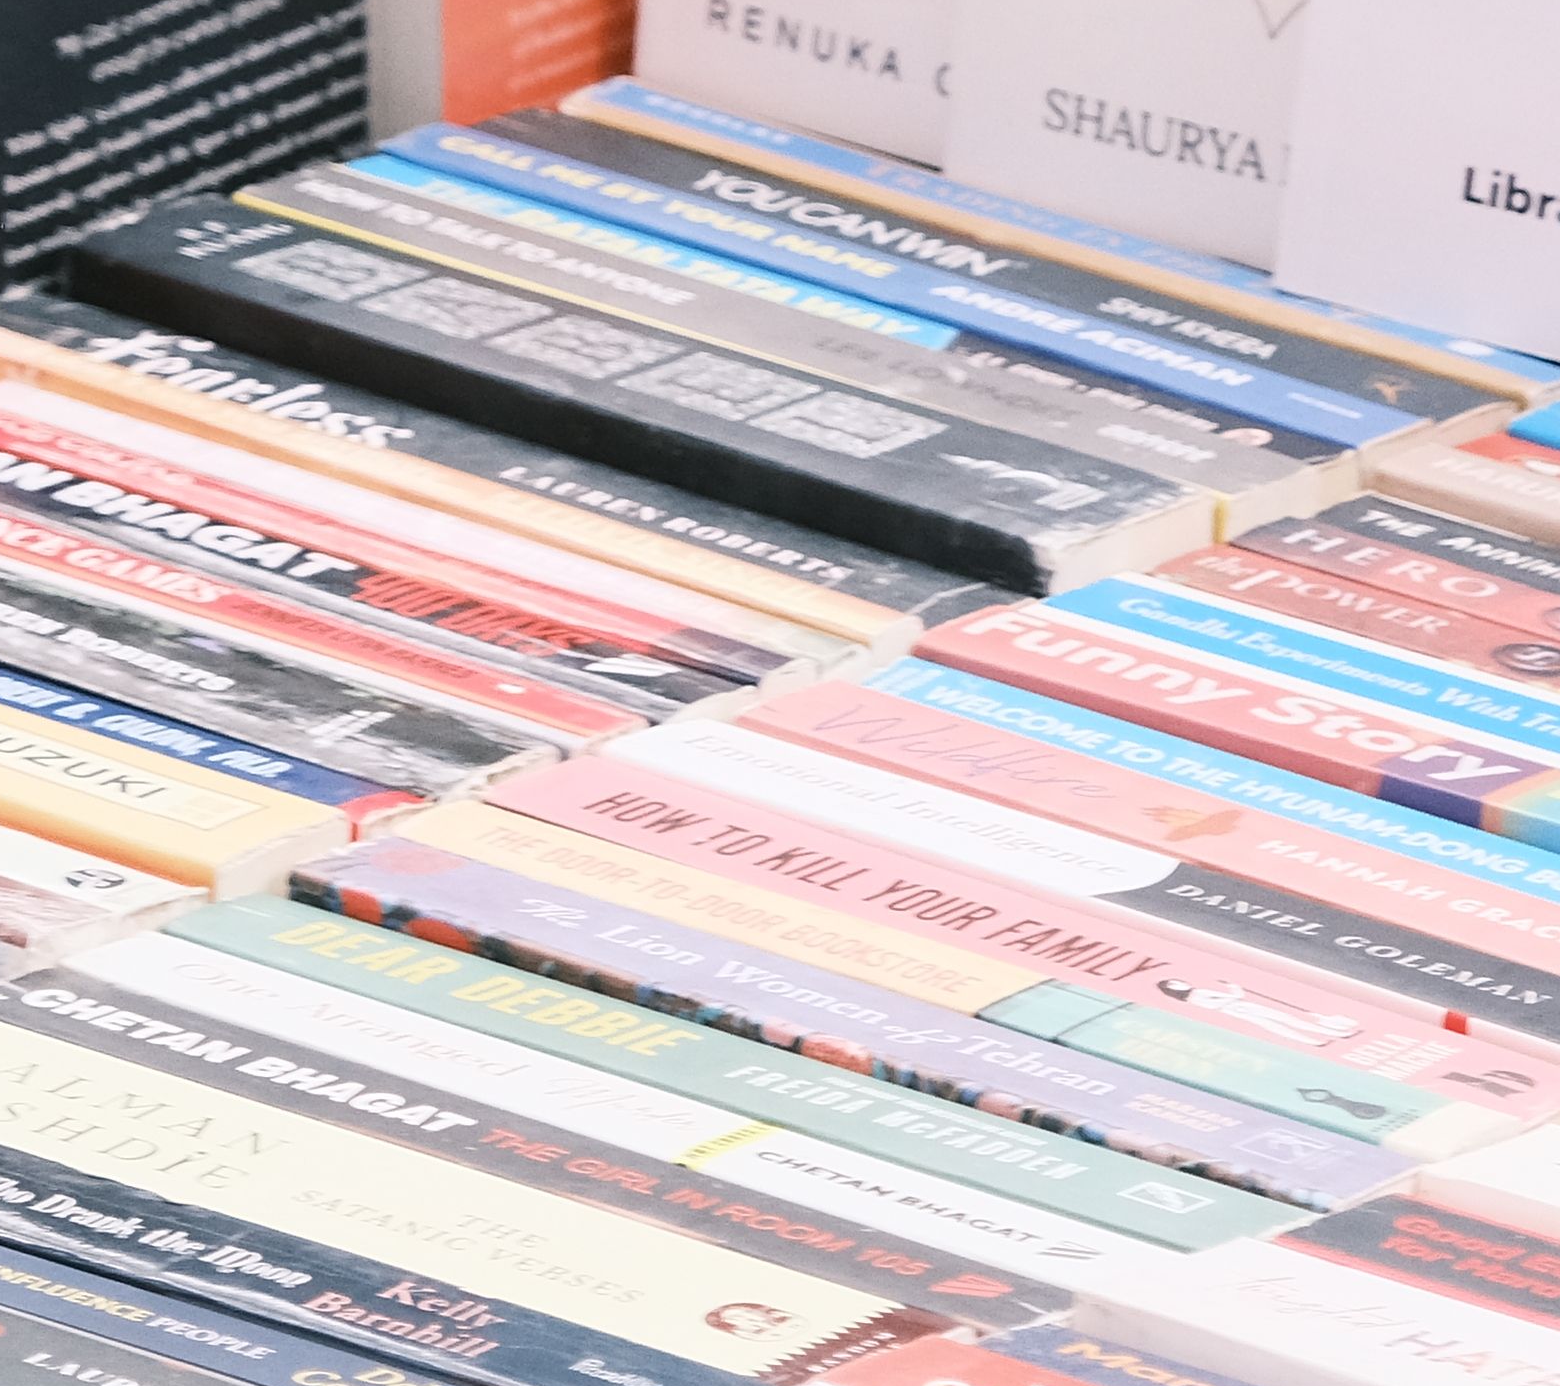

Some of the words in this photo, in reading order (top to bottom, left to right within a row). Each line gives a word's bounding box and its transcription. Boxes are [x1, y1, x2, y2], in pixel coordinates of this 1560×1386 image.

[1044, 88, 1268, 183] SHAURYA
[52, 474, 359, 578] BHAGAT
[1281, 525, 1503, 601] HERO
[1357, 508, 1426, 539] THE
[922, 683, 1110, 752] WELCOME
[1110, 734, 1164, 769] TO
[1162, 754, 1236, 791] THE
[962, 609, 1254, 707] Funny
[1251, 693, 1522, 783] Story
[582, 790, 694, 836] HOW
[688, 816, 763, 858] TO
[752, 839, 870, 894] KILL
[864, 876, 1000, 934] YOUR
[996, 919, 1172, 981] FAMILY
[1255, 836, 1449, 905] HANNAH
[1164, 879, 1323, 940] DANIEL
[1333, 930, 1553, 1006] GOLEMAN
[283, 921, 457, 988] DEAR
[454, 969, 706, 1058] DEBBIE
[725, 1065, 874, 1114] FREIDA
[595, 918, 703, 968] Lion
[713, 955, 889, 1024] Women
[954, 1033, 1118, 1099] Tehran
[20, 987, 240, 1064] CHETAN
[237, 1045, 478, 1133] BHAGAT
[480, 1126, 557, 1164] THE
[562, 1150, 670, 1195] GIRL
[856, 1244, 933, 1277] 105
[136, 1217, 209, 1256] the
[146, 1313, 279, 1361] PEOPLE
